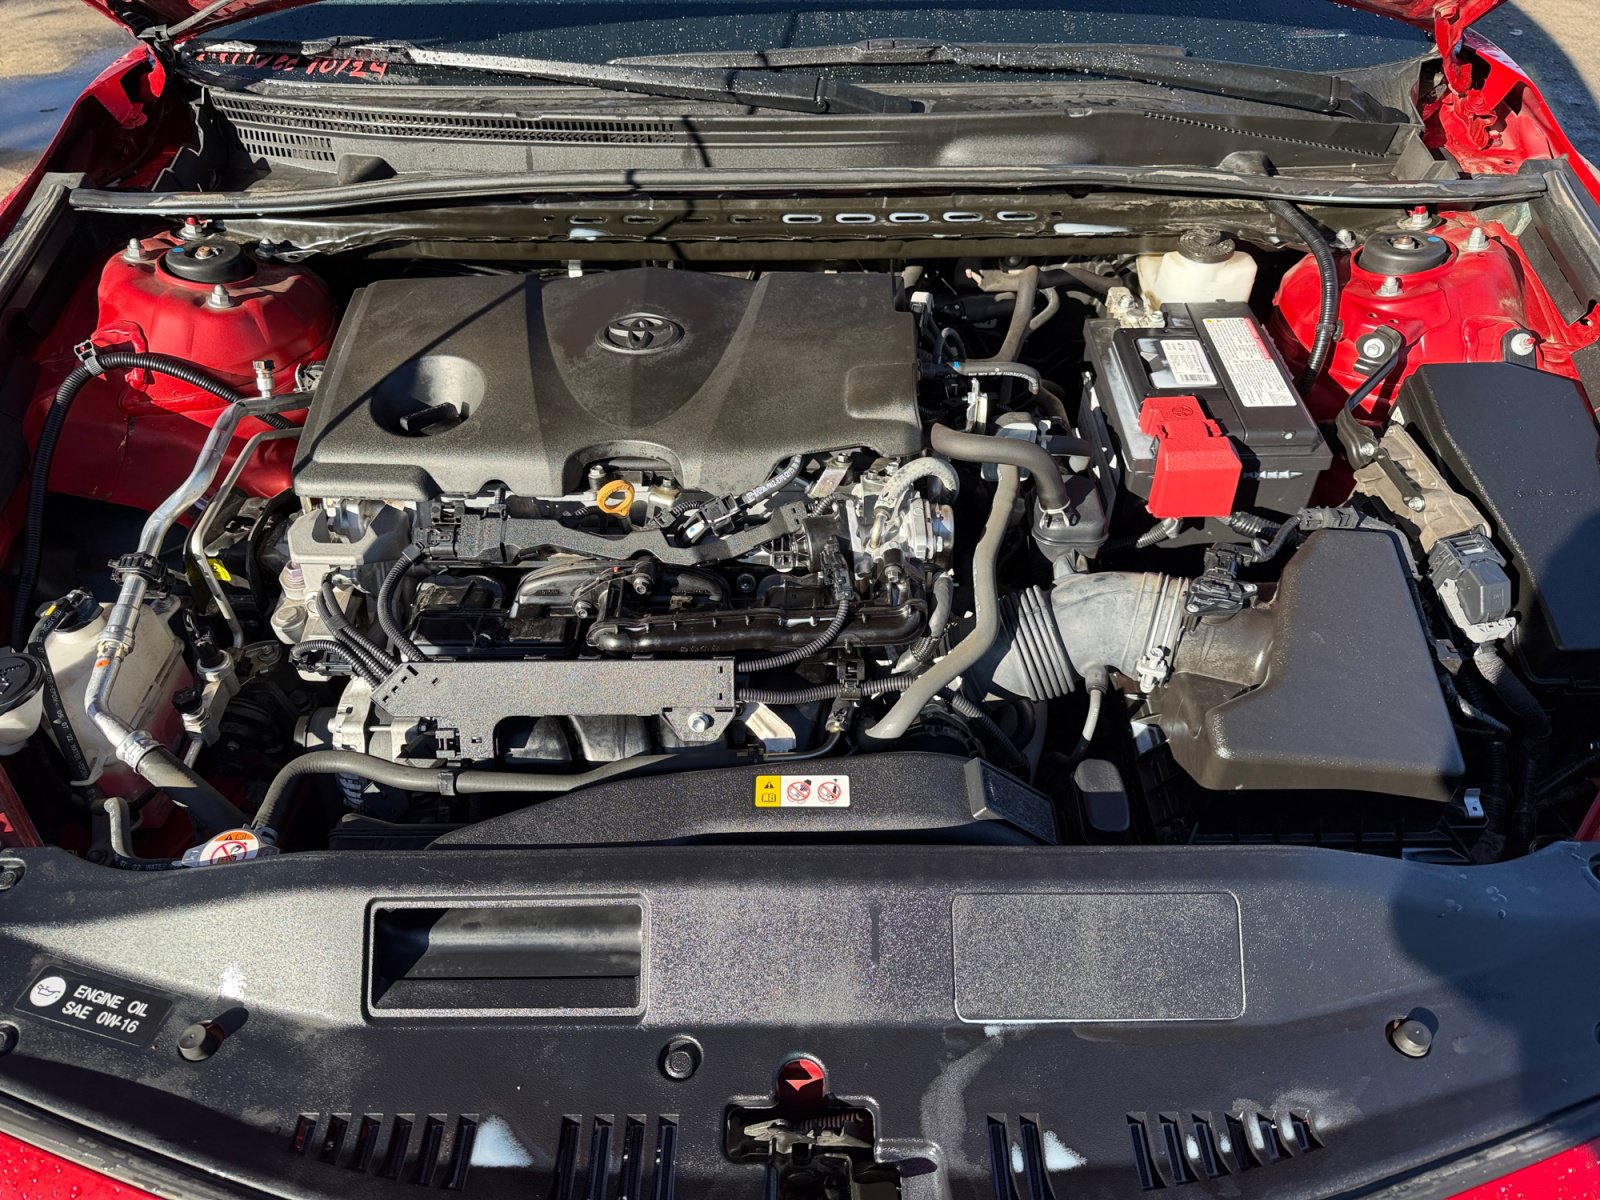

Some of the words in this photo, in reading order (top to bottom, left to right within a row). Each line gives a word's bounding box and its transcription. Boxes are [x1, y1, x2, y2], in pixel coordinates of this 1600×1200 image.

[62, 1001, 93, 1020] SAE
[96, 1011, 140, 1033] 0W-16
[73, 985, 125, 1009] ENGINE
[127, 1001, 148, 1018] OIL
